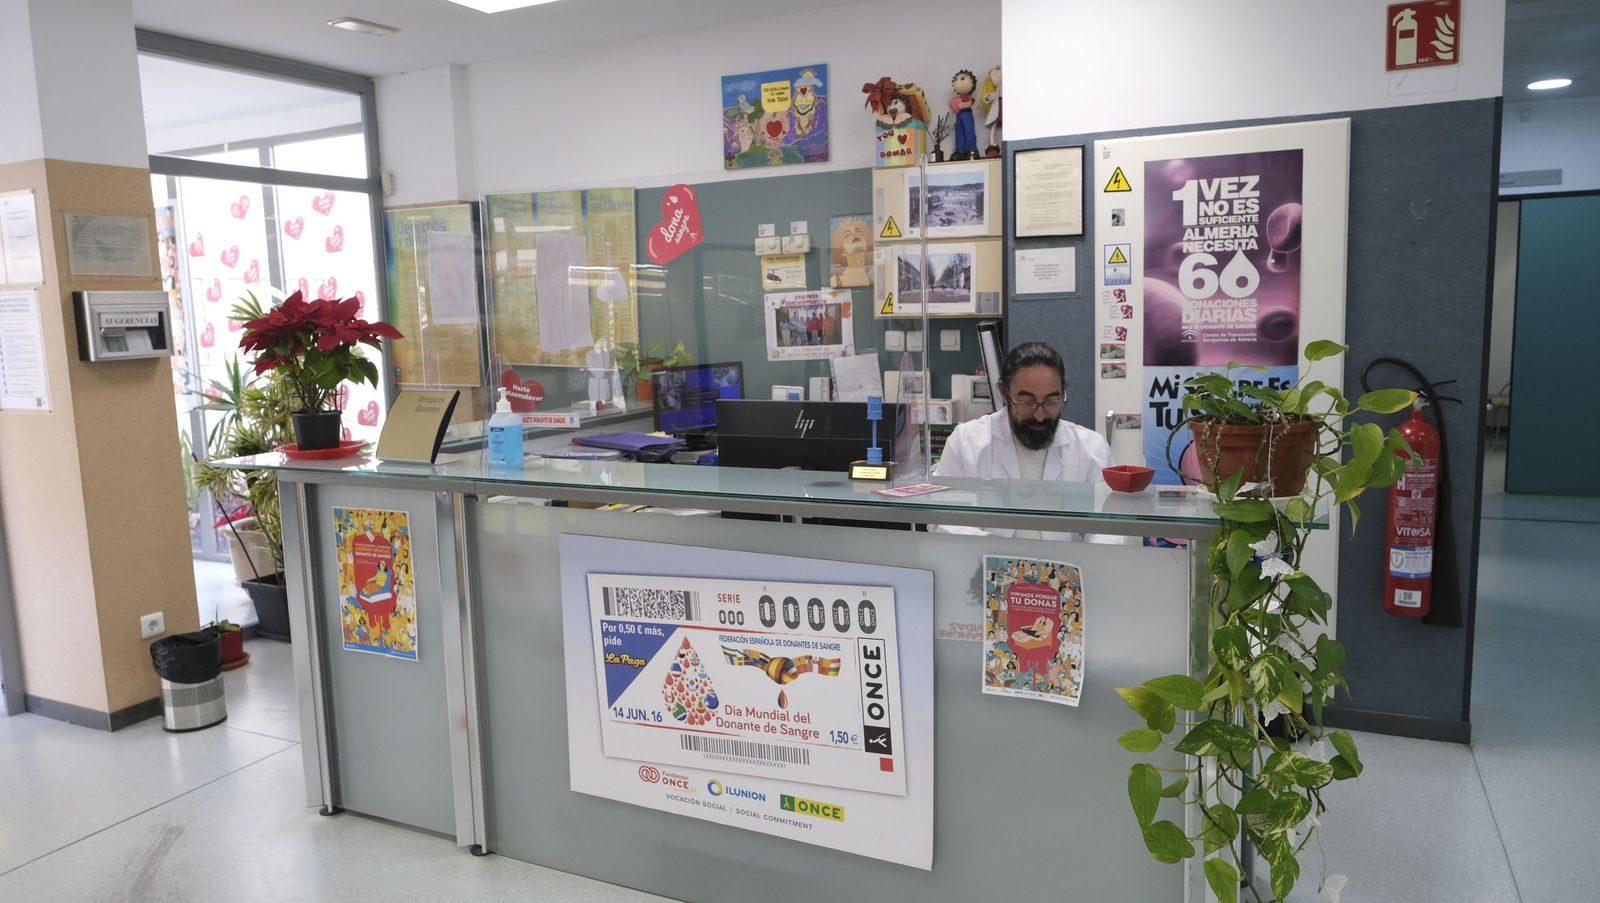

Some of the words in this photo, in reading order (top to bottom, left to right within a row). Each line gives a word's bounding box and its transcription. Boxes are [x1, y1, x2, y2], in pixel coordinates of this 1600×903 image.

[877, 130, 895, 142] YOU
[880, 148, 912, 158] DONAR
[1172, 179, 1198, 226] 1
[1199, 175, 1260, 200] VEZ
[1199, 200, 1230, 216] NO
[1233, 198, 1260, 215] ES
[660, 208, 684, 243] dona
[1199, 214, 1259, 225] SUFICIENTE
[675, 215, 690, 244] sangre
[1183, 225, 1258, 240] ALMERIA
[1183, 238, 1258, 253] NECESITA
[1178, 246, 1260, 299] 60
[104, 317, 158, 325] SUGERENCIAS
[1182, 308, 1257, 323] DIARIAS
[512, 384, 531, 393] Hazte
[794, 409, 815, 438] hp
[717, 593, 741, 604] SERIE
[1010, 597, 1021, 605] TU
[1024, 598, 1057, 608] DONAS
[718, 609, 744, 626] 000
[602, 622, 617, 633] Por
[618, 623, 636, 634] 0,50
[637, 625, 643, 634] €
[644, 626, 665, 637] más,
[604, 636, 622, 647] pide
[719, 635, 749, 644] FEDERACIÓN
[749, 637, 775, 646] ESPAÑOLA
[783, 640, 811, 649] DONANTES
[819, 643, 841, 651] SANGRE
[606, 653, 620, 664] La
[620, 653, 647, 668] Paga
[863, 645, 885, 720] ONCE
[612, 707, 624, 718] 14
[626, 708, 650, 721] JUN.
[651, 711, 663, 722] 16
[745, 707, 790, 722] Mundial
[793, 713, 811, 724] del
[716, 717, 760, 732] Donante
[763, 722, 777, 734] de
[780, 724, 820, 740] Sangre
[829, 730, 849, 745] 1,50
[851, 735, 859, 745] €
[662, 777, 689, 790] ONCE
[725, 786, 766, 802] ILUNION
[666, 793, 701, 806] VOCACIÓN
[702, 801, 727, 812] SOCIAL
[735, 808, 761, 819] SOCIAL
[763, 814, 813, 830] COMMITMENT
[798, 801, 841, 819] ONCE
